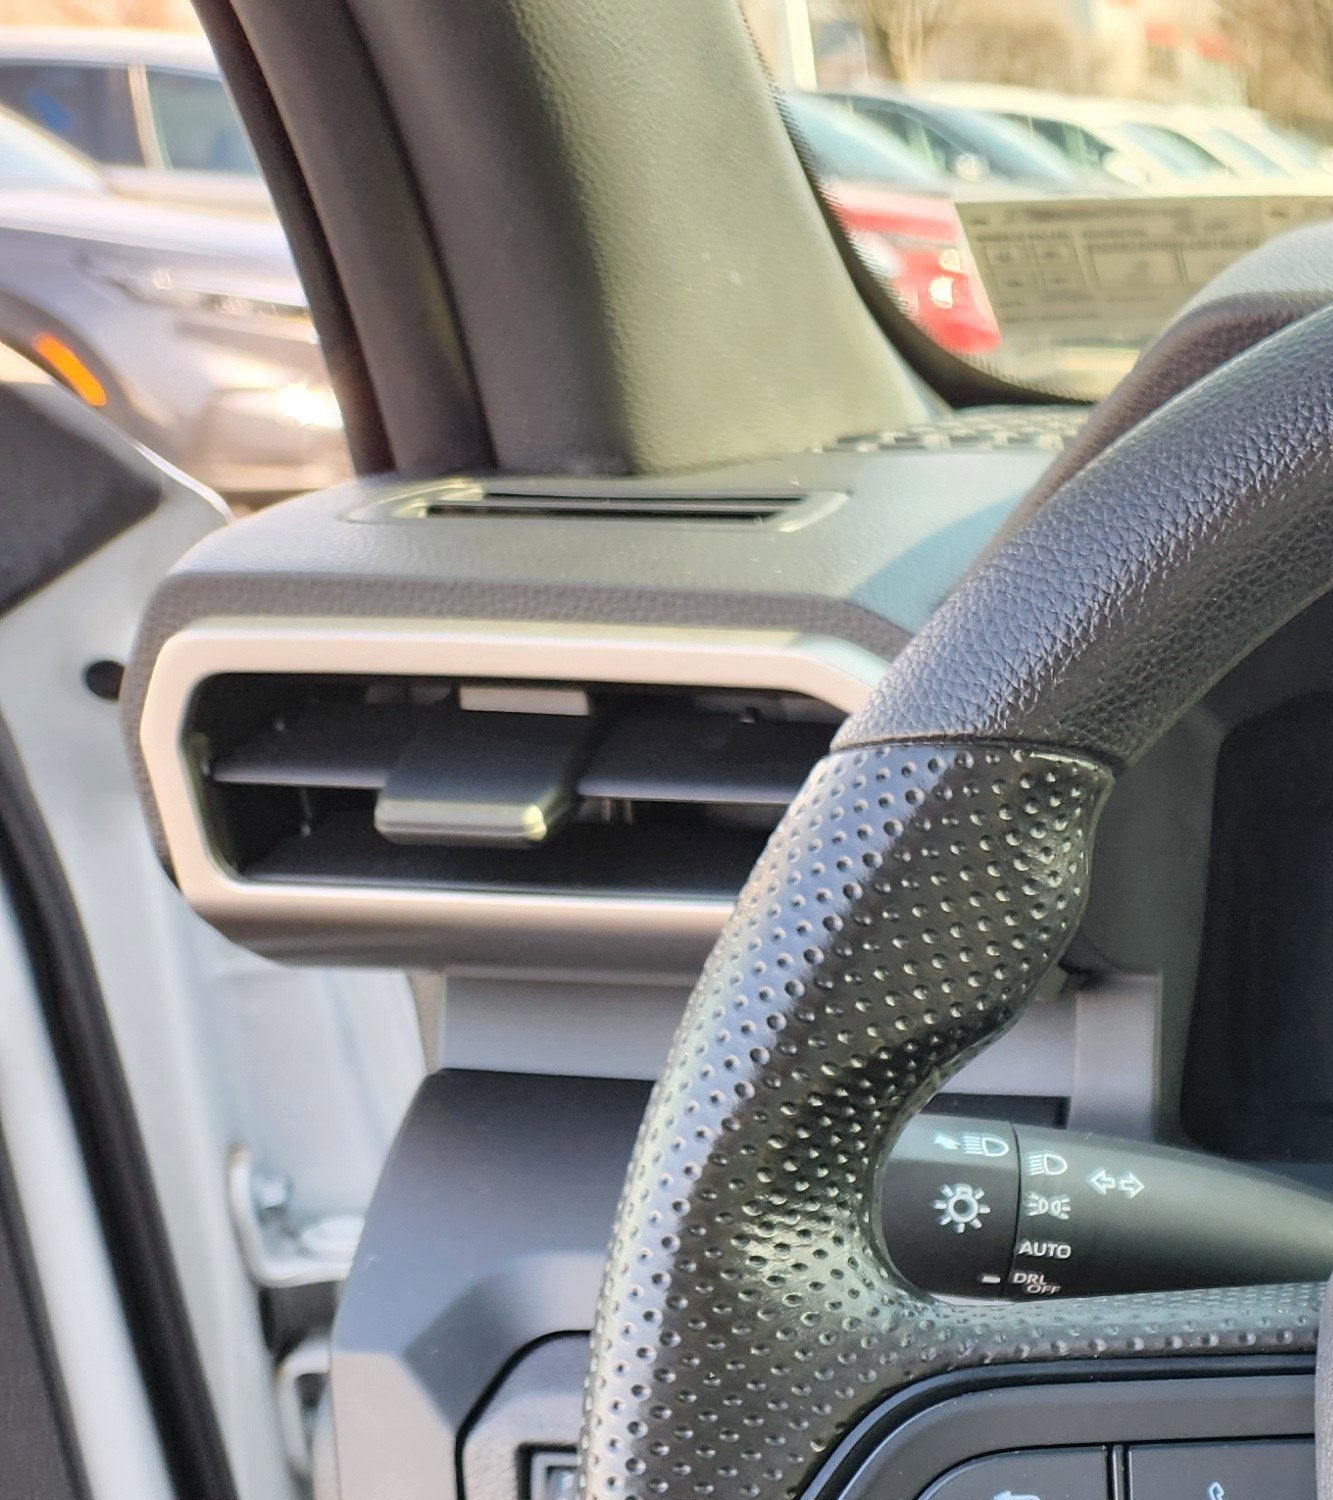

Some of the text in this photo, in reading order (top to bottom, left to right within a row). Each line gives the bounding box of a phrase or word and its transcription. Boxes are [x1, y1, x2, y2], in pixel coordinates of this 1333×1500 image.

[1018, 1240, 1072, 1259] AUTO
[1013, 1272, 1047, 1285] DRL
[1026, 1284, 1061, 1295] OFF
